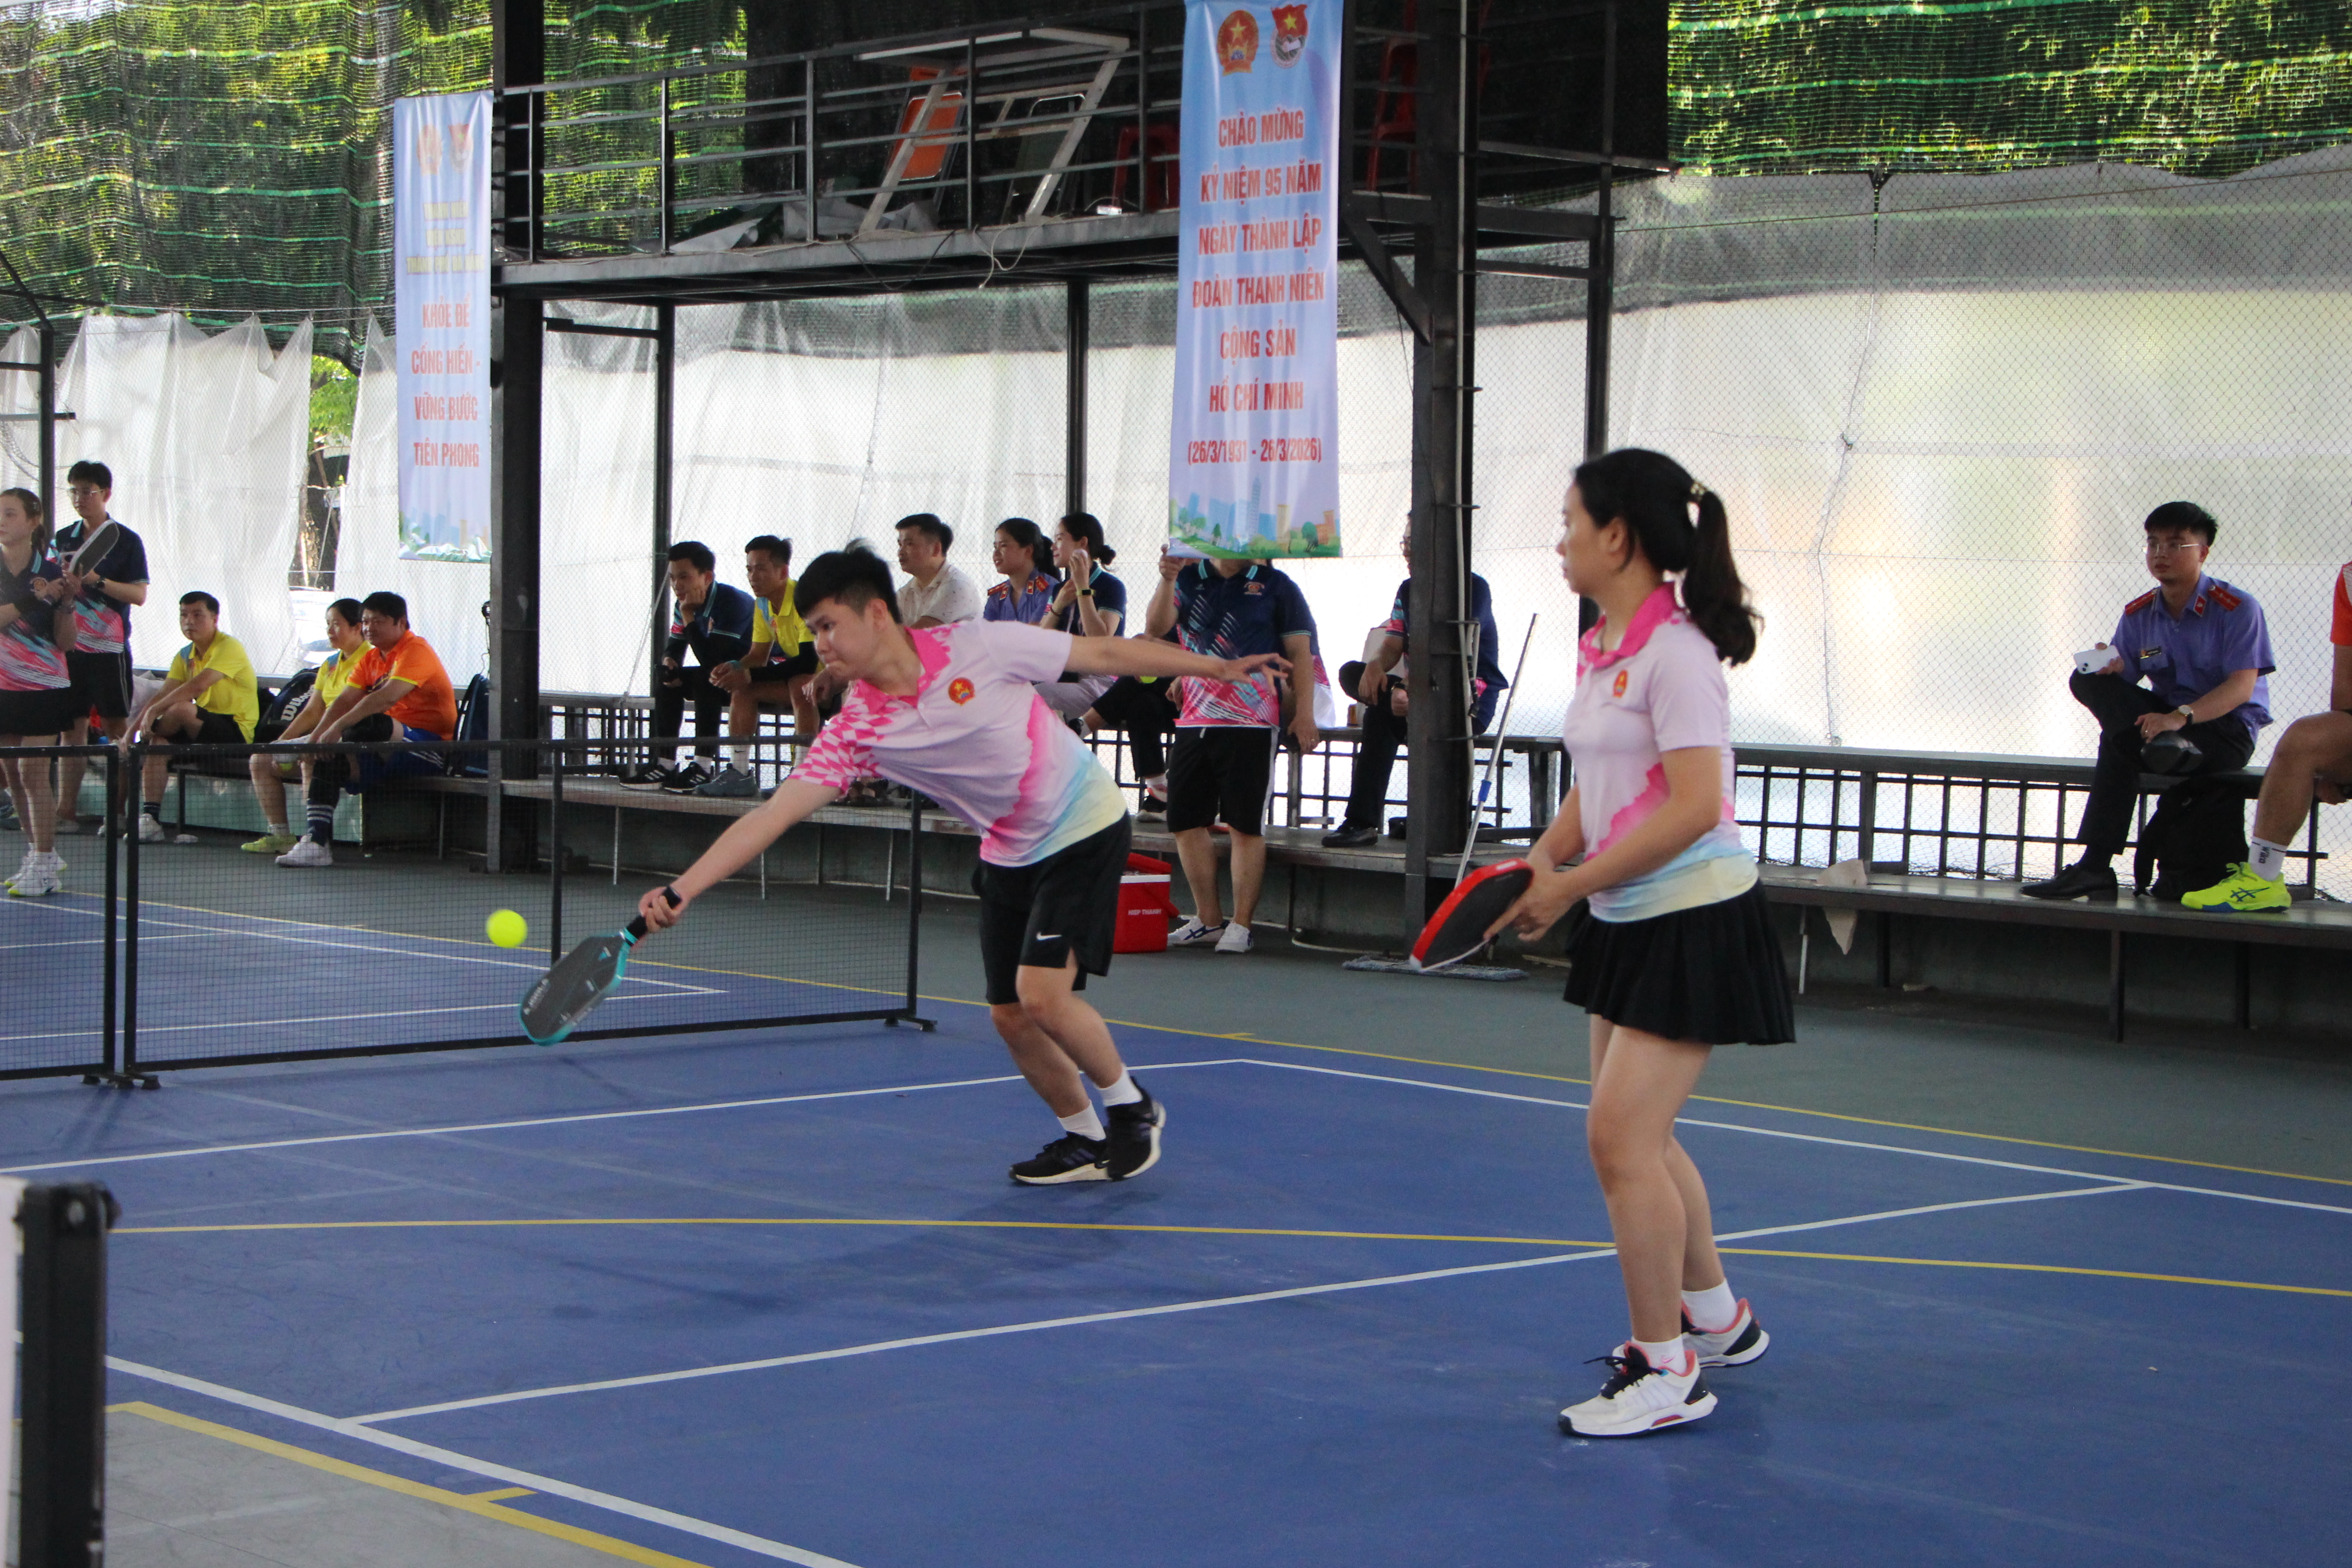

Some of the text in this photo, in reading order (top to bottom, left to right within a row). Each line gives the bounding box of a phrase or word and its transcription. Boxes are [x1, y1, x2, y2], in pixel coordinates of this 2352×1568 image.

[1219, 107, 1304, 147] CHÀO MỪNG
[1201, 159, 1322, 205] KỶ NIỆM 95 NĂM
[1199, 213, 1322, 255] NGÀY THÀNH LẬP
[1192, 267, 1325, 309] ĐOÀN THANH NIÊN
[422, 295, 452, 328] KHỎE
[412, 342, 443, 374] CỐNG
[446, 342, 473, 374] HIẾN
[1220, 319, 1296, 365] CỘNG SẢN
[414, 392, 479, 421] VỮNG BƯỚC
[1209, 376, 1304, 412] HỒ CHÍ MINH
[414, 437, 480, 468] TIÊN PHONG
[1188, 439, 1248, 466] (26/3/1931
[1259, 437, 1323, 463] 26/3/2026)
